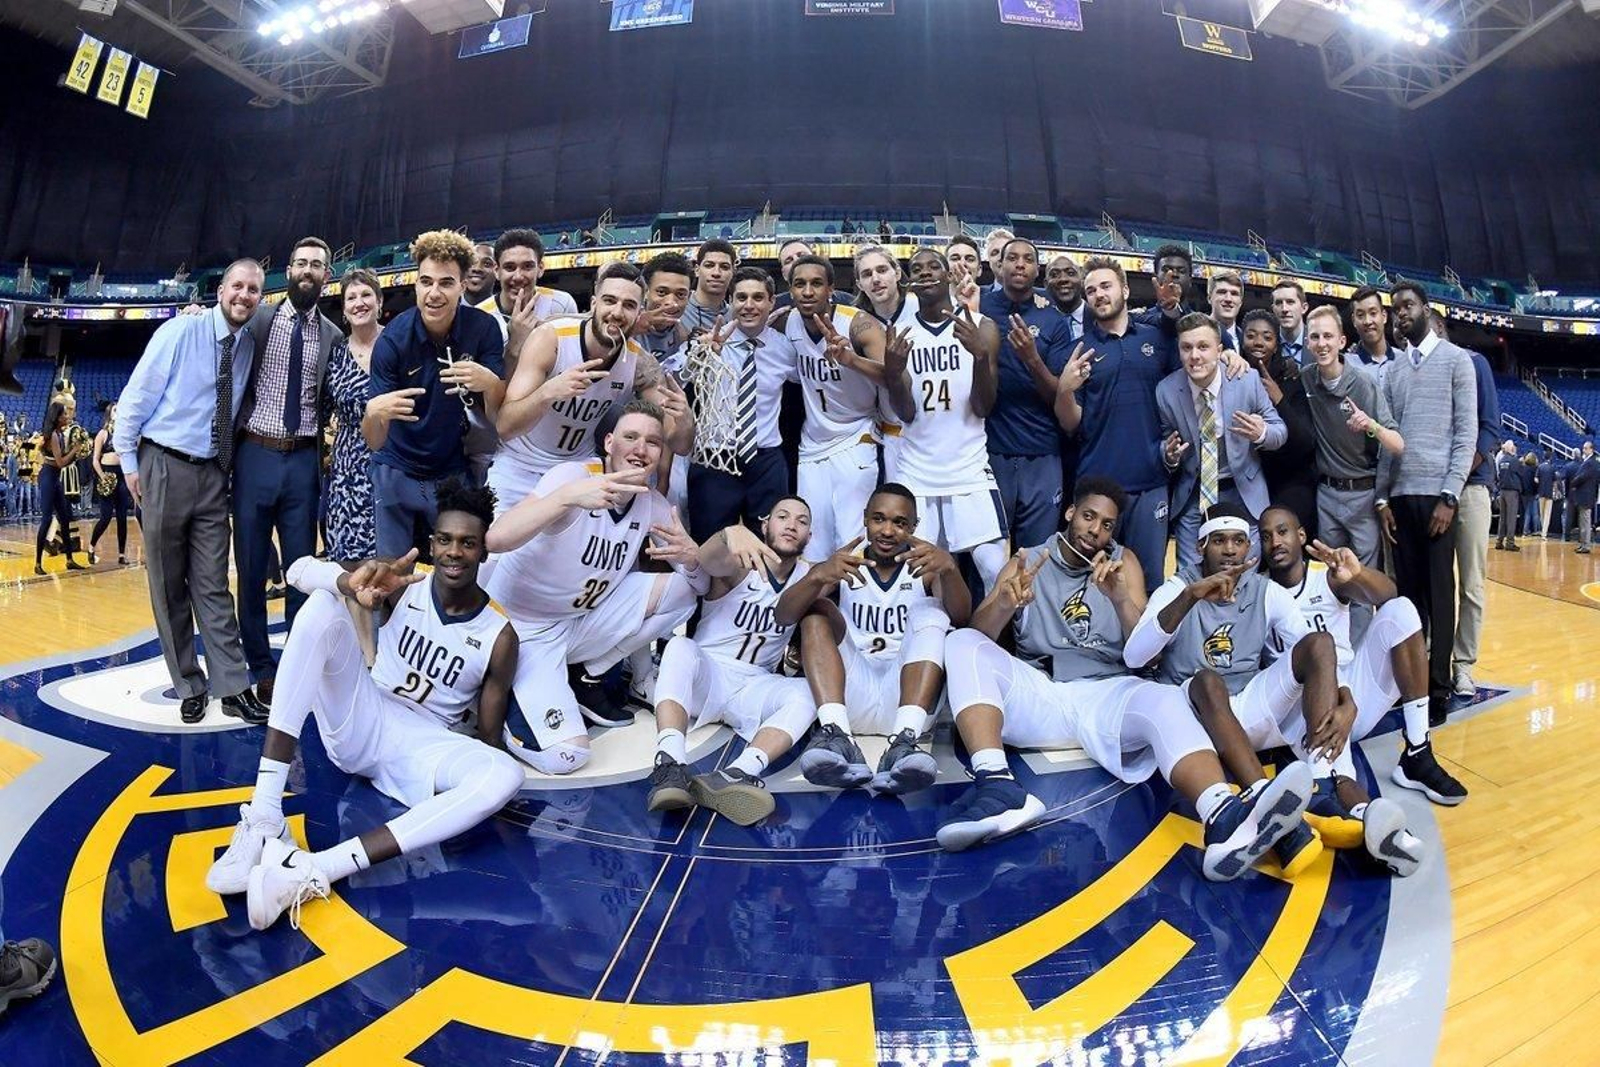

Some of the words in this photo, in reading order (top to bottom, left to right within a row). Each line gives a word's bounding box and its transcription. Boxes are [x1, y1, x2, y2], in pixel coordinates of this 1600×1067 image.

[1004, 14, 1042, 23] WESTERN
[1043, 18, 1079, 27] CAROLINA
[1025, 0, 1056, 18] WCU
[1203, 24, 1221, 38] W
[76, 60, 90, 80] 42
[106, 72, 120, 92] 23
[137, 87, 146, 104] 5
[910, 344, 960, 375] UNCG
[815, 389, 827, 412] 1
[922, 379, 951, 411] 24
[557, 425, 586, 452] 10
[572, 578, 610, 609] 32
[852, 602, 908, 635] UNCG
[397, 624, 465, 689] UNCG
[393, 671, 435, 704] 21
